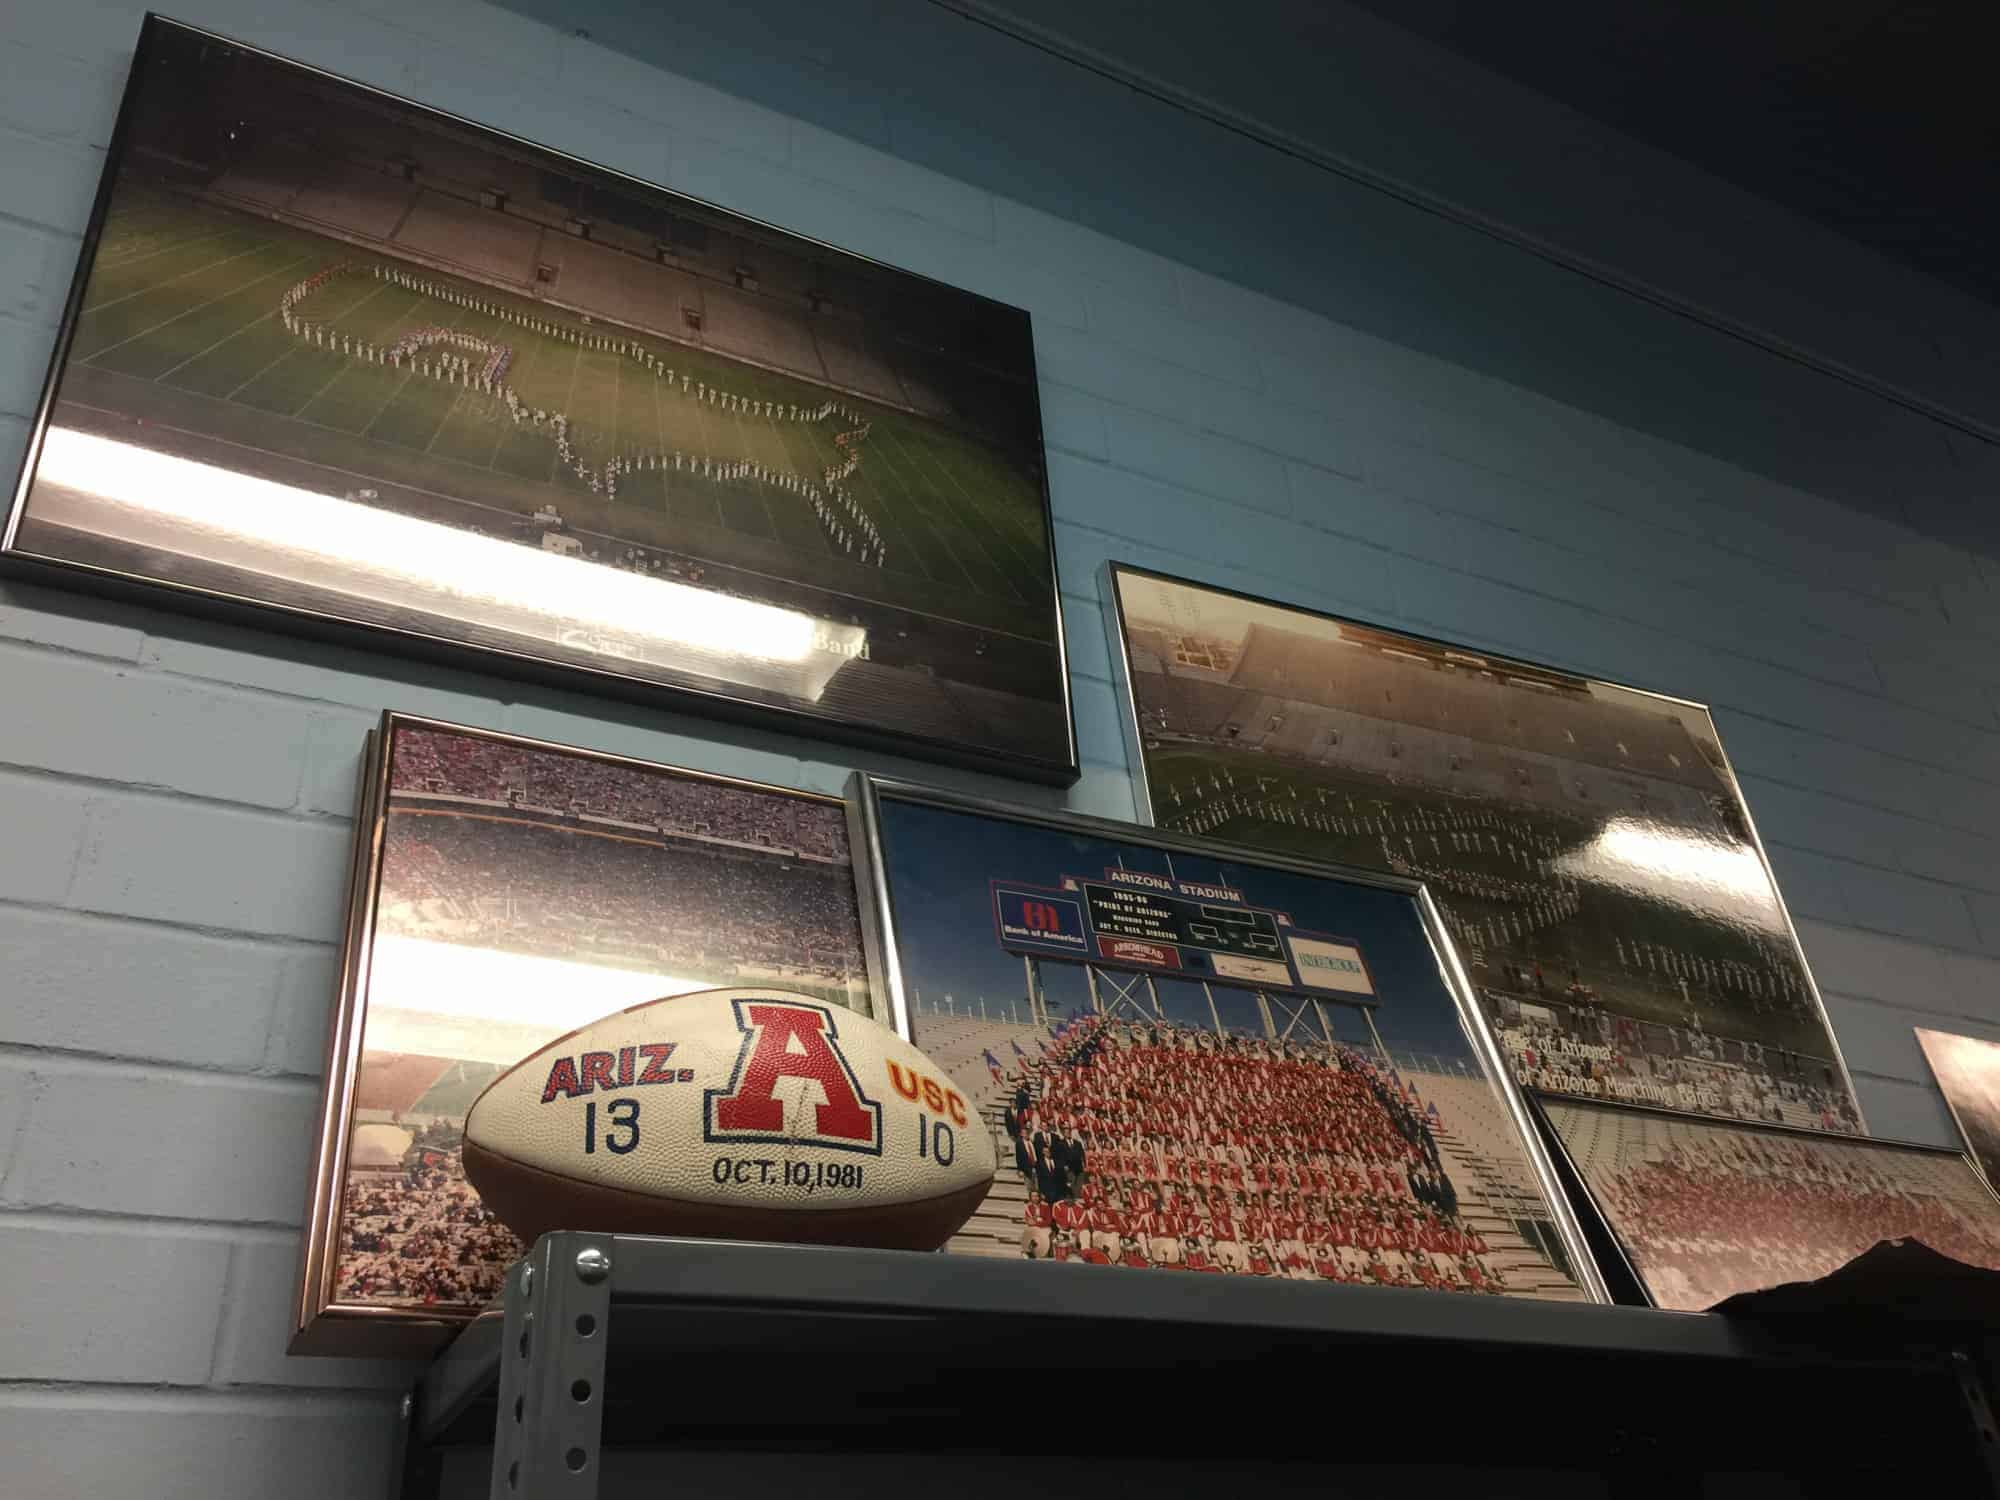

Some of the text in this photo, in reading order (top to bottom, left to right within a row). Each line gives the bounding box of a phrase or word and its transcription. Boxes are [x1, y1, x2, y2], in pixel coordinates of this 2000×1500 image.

[815, 631, 871, 661] Band
[1111, 871, 1241, 902] ARIZONA STADIUM
[1004, 924, 1084, 944] Bank of America
[1113, 942, 1165, 960] ARROWHEAD
[1539, 1035, 1553, 1054] of
[541, 1043, 695, 1104] ARIZ.
[704, 999, 882, 1156] A
[1516, 1069, 1534, 1086] of
[1541, 1071, 1600, 1096] Arizona
[1604, 1075, 1673, 1107] Marching
[886, 1058, 969, 1128] USC
[584, 1098, 640, 1155] 13
[919, 1113, 955, 1167] 10
